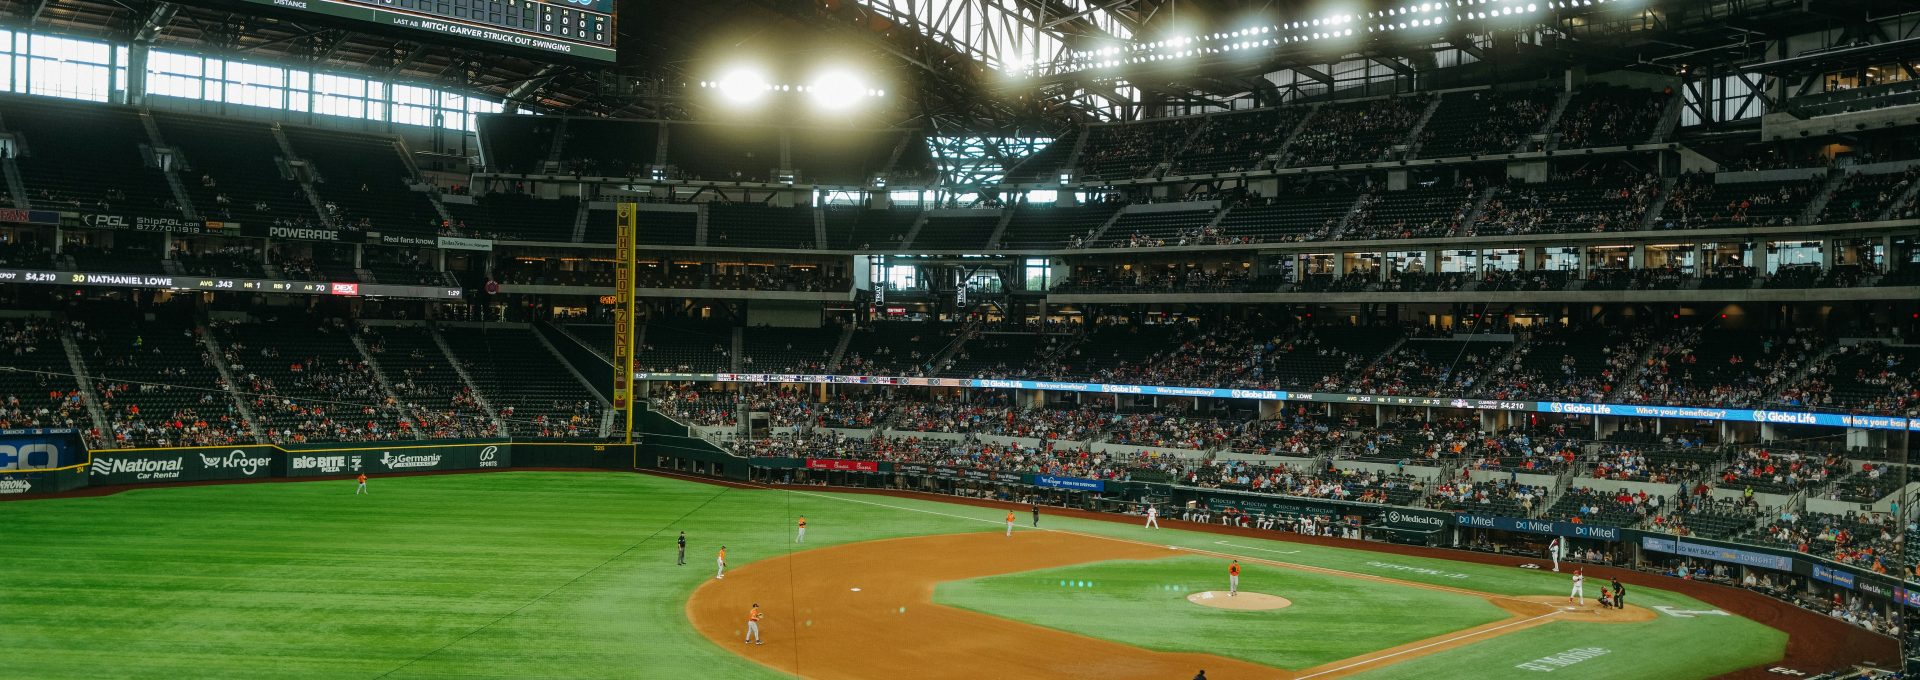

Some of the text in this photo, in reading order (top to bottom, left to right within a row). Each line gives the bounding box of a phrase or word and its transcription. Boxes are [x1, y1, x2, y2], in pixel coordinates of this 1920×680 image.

[274, 0, 307, 8] DISTANCE
[422, 21, 447, 32] MITCH
[450, 25, 481, 37] GARVER
[483, 31, 513, 42] STRUCK
[515, 37, 531, 46] OUT
[532, 40, 571, 52] SWINGING
[96, 215, 129, 226] PGL
[137, 217, 200, 226] ShipPGL.com
[137, 224, 200, 233] 877.701.1919
[270, 227, 338, 240] POWERADE
[619, 227, 627, 258] THE
[25, 273, 56, 282] $4,210
[88, 275, 142, 285] NATHANIEL
[145, 277, 172, 286] LOWE
[619, 269, 627, 302] HOT
[618, 310, 626, 356] ZONE
[1564, 404, 1592, 413] Globe
[1593, 404, 1611, 414] Life
[1679, 410, 1726, 418] beneficiary?
[1768, 412, 1796, 422] Globe
[1798, 413, 1816, 424] Life
[223, 450, 272, 476] Kroger
[317, 456, 345, 467] BITE
[398, 453, 440, 462] Germania
[112, 457, 183, 473] National
[0, 480, 22, 489] RROW
[1401, 515, 1444, 527] Medical City
[1471, 516, 1615, 538] Mitel Mitel Mitel
[1741, 555, 1773, 564] TONIGHT
[1860, 582, 1872, 591] Globe
